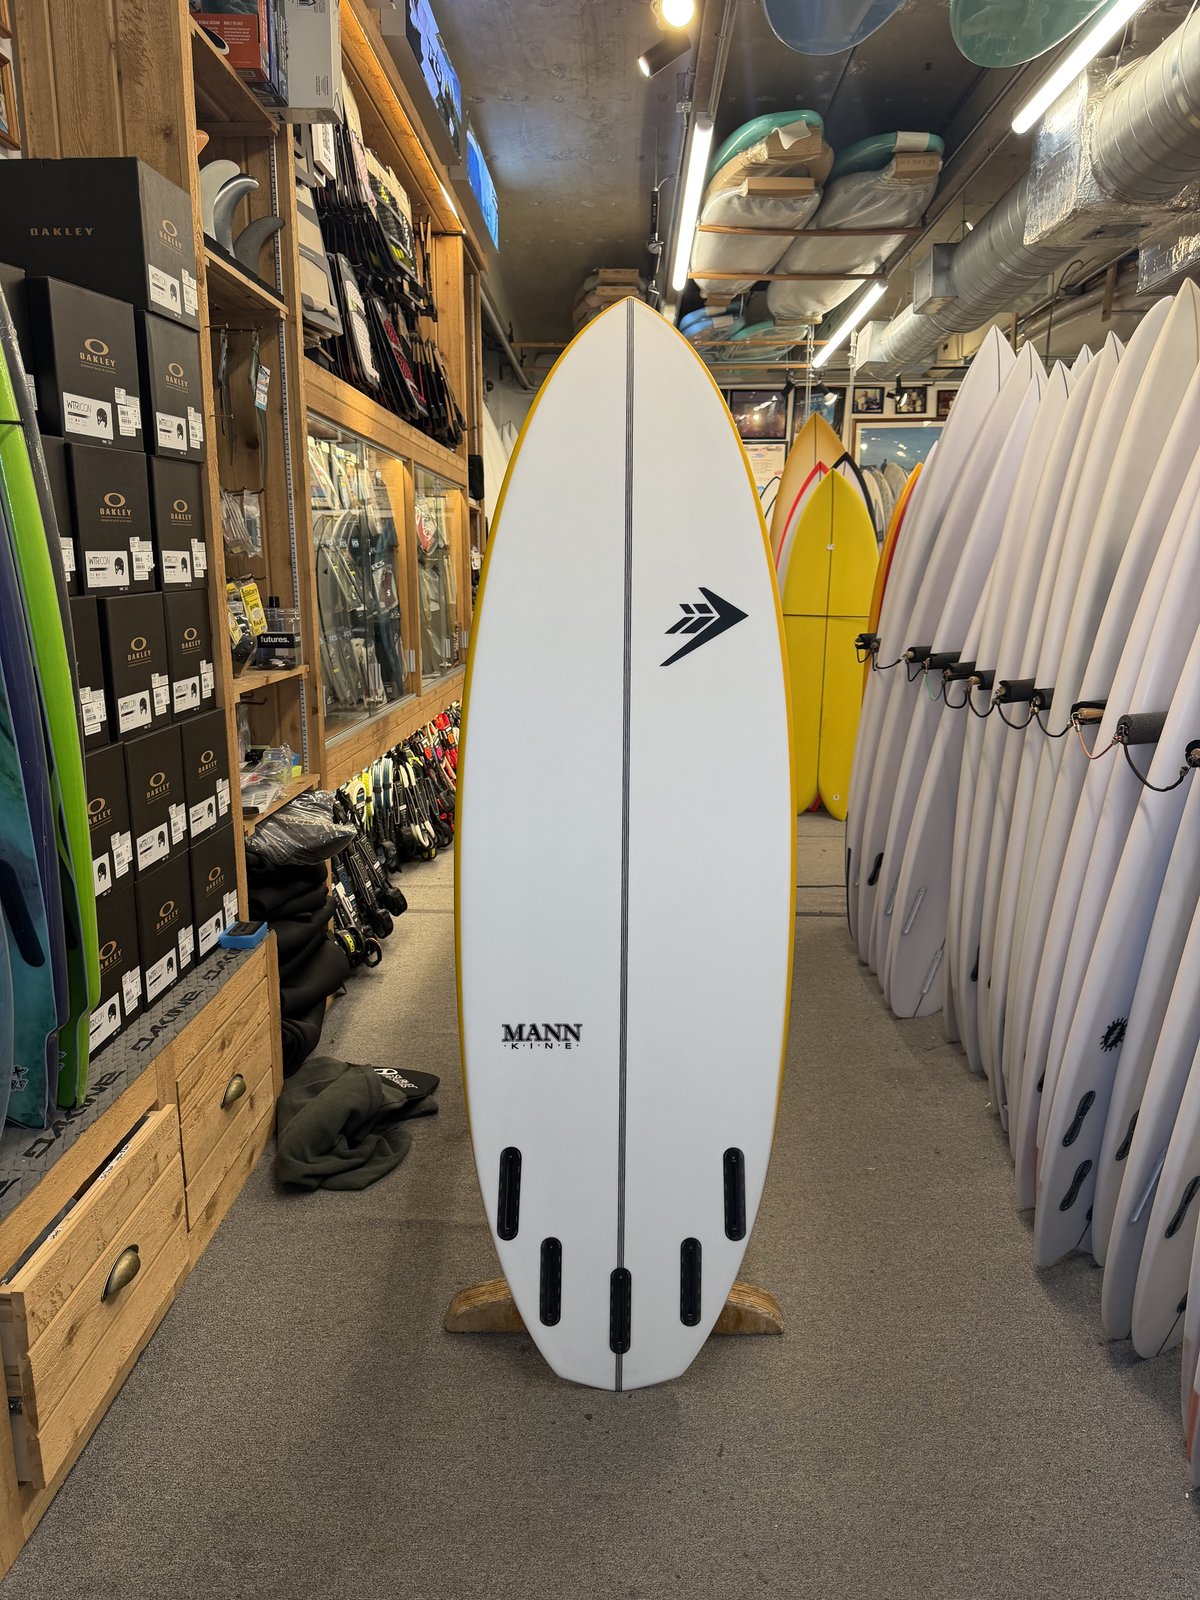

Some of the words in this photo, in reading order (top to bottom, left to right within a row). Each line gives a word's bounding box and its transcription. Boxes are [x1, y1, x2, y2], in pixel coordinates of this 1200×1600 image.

[29, 227, 95, 236] OAKLEY
[159, 230, 183, 249] OAKLEY
[79, 352, 116, 368] OAKLEY
[165, 375, 189, 388] OAKLEY
[99, 507, 132, 517] OAKLEY
[170, 513, 192, 521] OAKLEY
[181, 640, 201, 649] OAKLEY
[127, 650, 151, 661] OAKLEY
[198, 760, 218, 774] OAKLEY
[146, 782, 170, 799] OAKLEY
[88, 808, 112, 825] AKLEY
[206, 874, 225, 892] OAKLEY
[156, 908, 179, 930] OAKLEY
[100, 948, 123, 970] AKLEY
[502, 1023, 583, 1042] MANN
